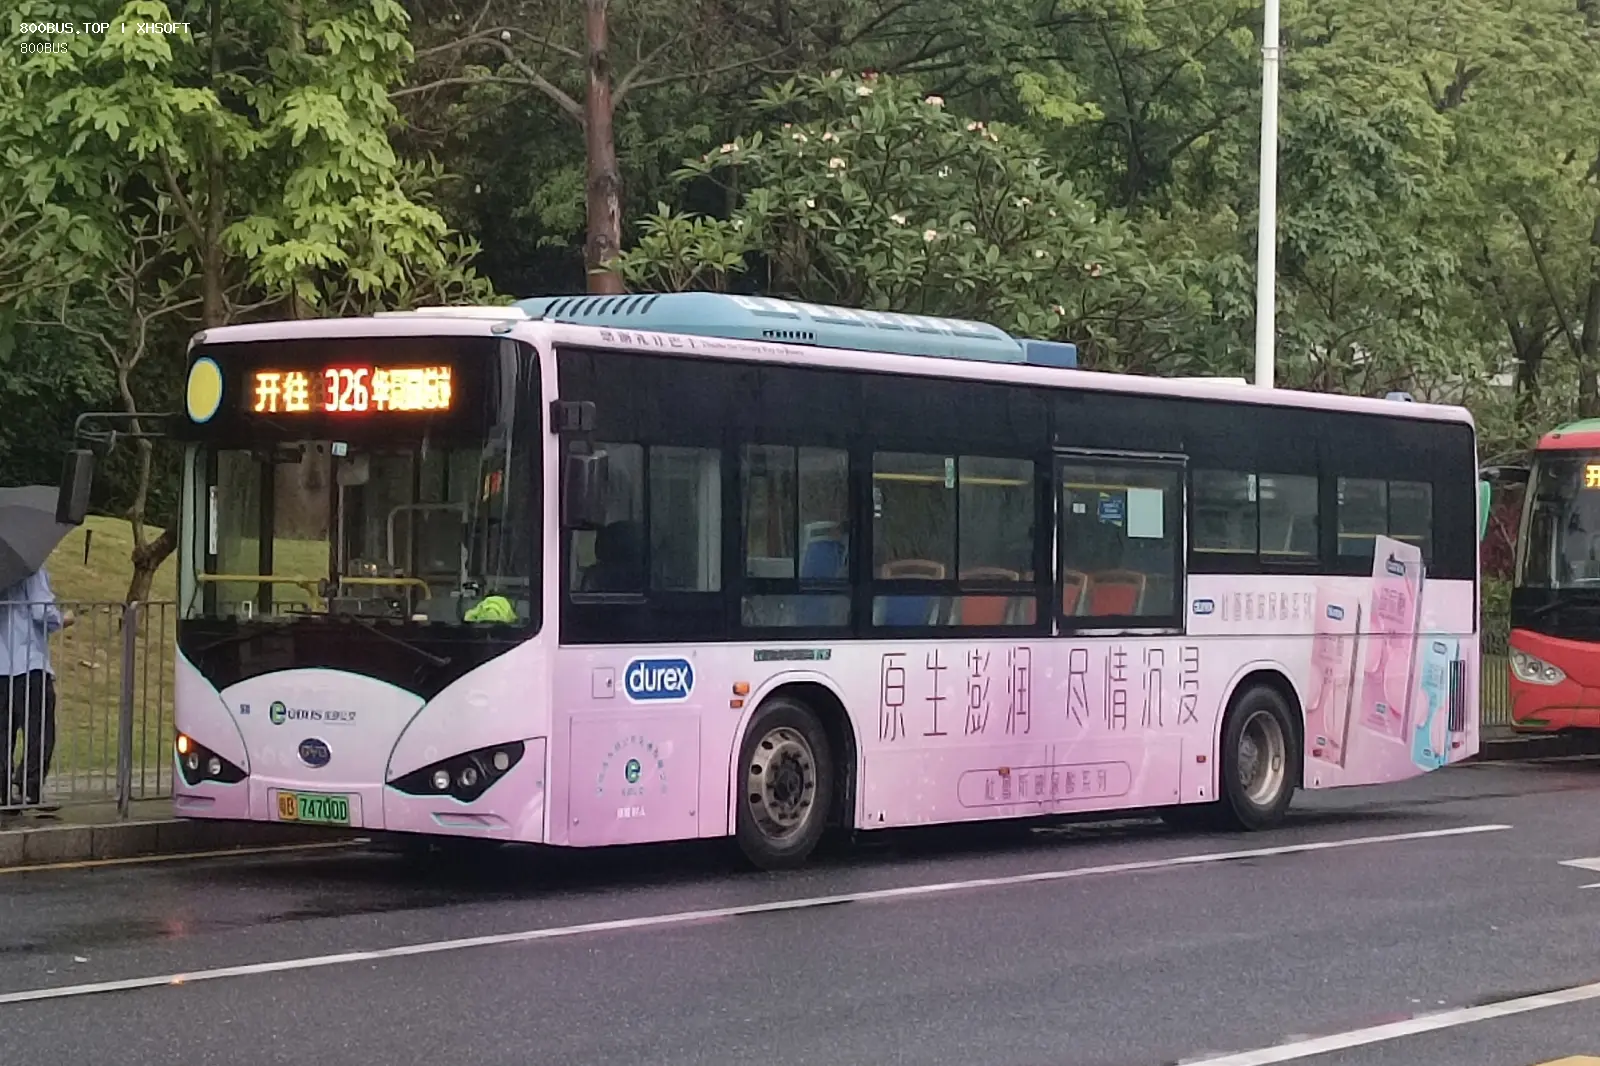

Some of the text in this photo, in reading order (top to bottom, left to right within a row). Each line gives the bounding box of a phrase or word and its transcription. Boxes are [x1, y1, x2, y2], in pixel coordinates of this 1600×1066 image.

[325, 368, 369, 412] 326
[629, 662, 691, 696] durex
[878, 646, 1032, 742] 原生澎润
[299, 797, 348, 821] 74700D
